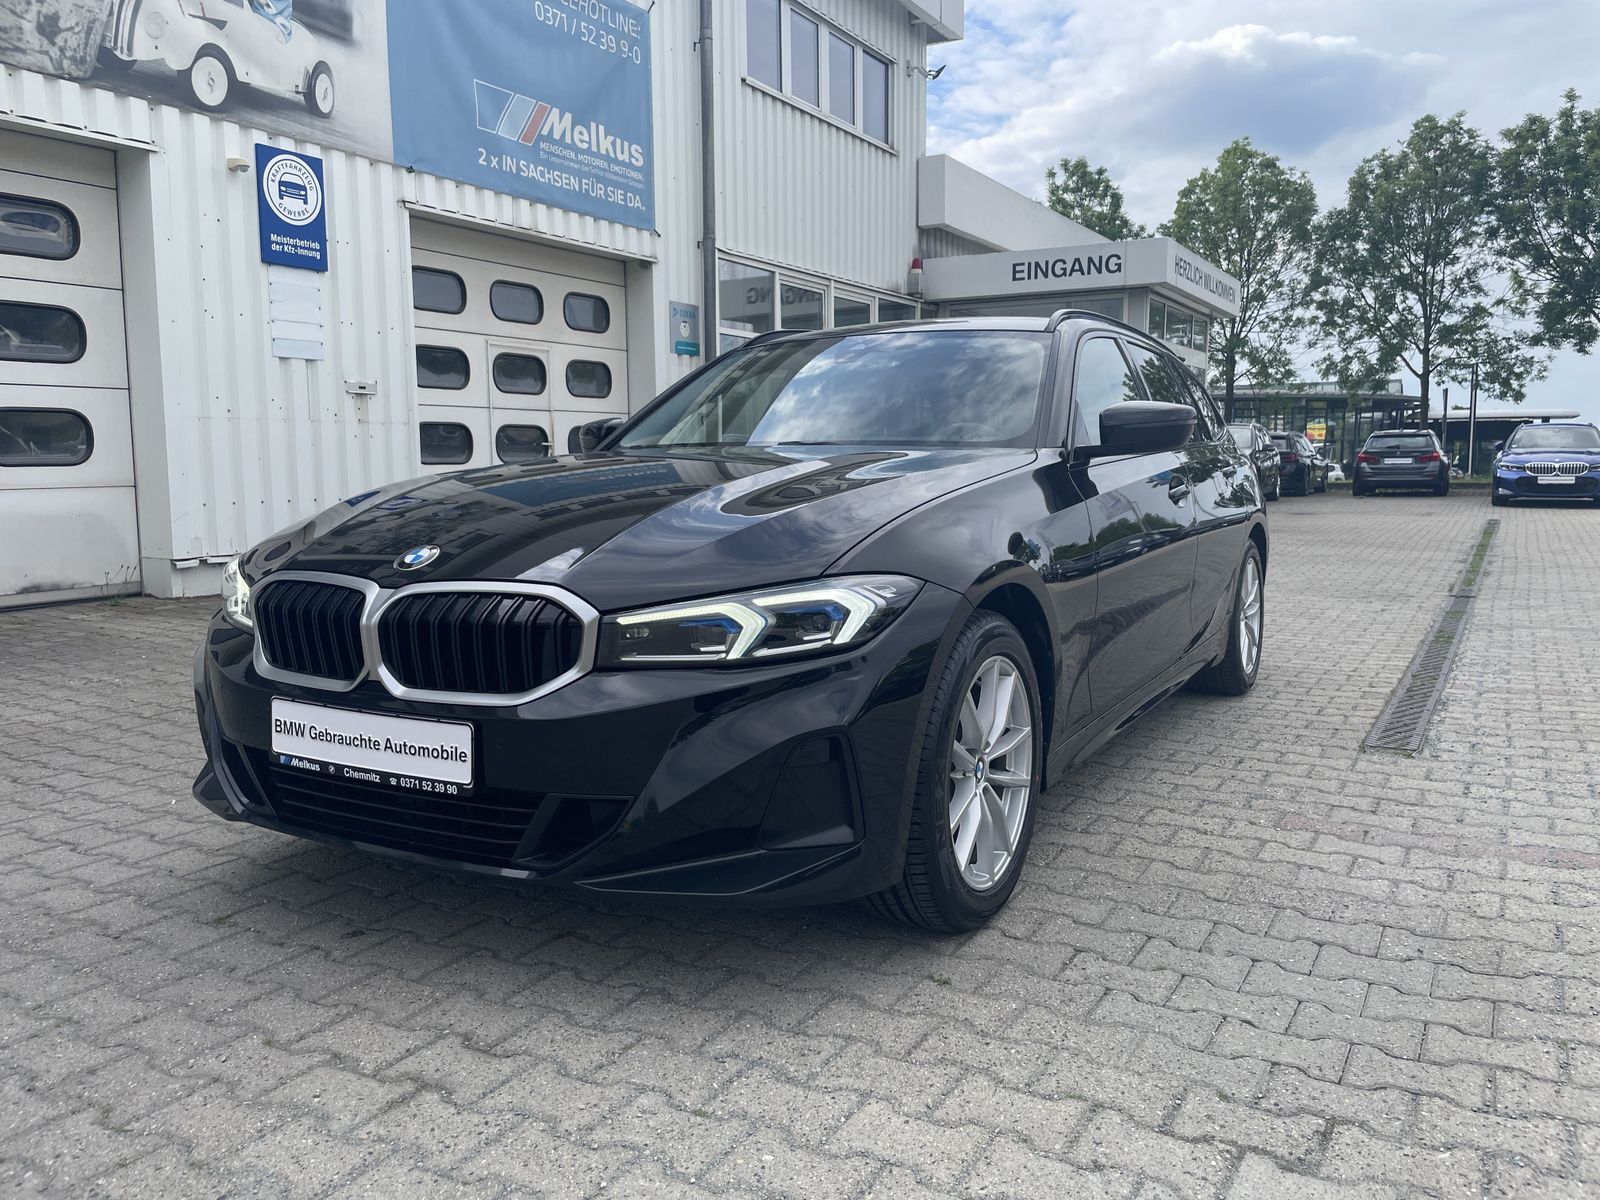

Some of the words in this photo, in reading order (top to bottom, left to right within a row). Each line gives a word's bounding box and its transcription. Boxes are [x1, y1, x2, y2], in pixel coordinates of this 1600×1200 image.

[535, 1, 567, 32] 0371
[571, 18, 577, 35] /
[580, 21, 596, 46] 52
[599, 30, 616, 53] 39
[620, 40, 640, 64] 9-0
[562, 0, 640, 39] EHOTLINE:
[541, 107, 644, 167] Melkus
[270, 162, 314, 191] KRAFTFAHRZEUG
[478, 148, 487, 165] 2
[491, 156, 498, 169] x
[502, 155, 516, 173] IN
[519, 160, 579, 191] SACHSEN
[582, 177, 605, 199] FÜR
[607, 188, 625, 205] SIE
[627, 193, 646, 210] DA.
[540, 141, 576, 160] MENSCHEN.
[577, 153, 609, 170] MOTOREN.
[610, 163, 644, 181] EMOTIONEN.
[278, 202, 310, 217] GEWERBE
[271, 233, 320, 249] Meisterbetrieb
[271, 242, 283, 252] der
[284, 244, 320, 259] Kfz-Innung
[1012, 254, 1122, 281] EINGANG
[1175, 254, 1203, 287] HERZLICH
[1203, 271, 1236, 304] WILLKOMMEN
[274, 718, 306, 739] BMW
[309, 725, 381, 751] Gebrauchte
[384, 737, 468, 763] Automobile
[291, 757, 320, 772] Melkus
[343, 767, 380, 783] Chemnitz
[400, 778, 419, 789] 0371
[422, 781, 432, 791] 52
[434, 783, 445, 793] 39
[446, 784, 458, 795] 90
